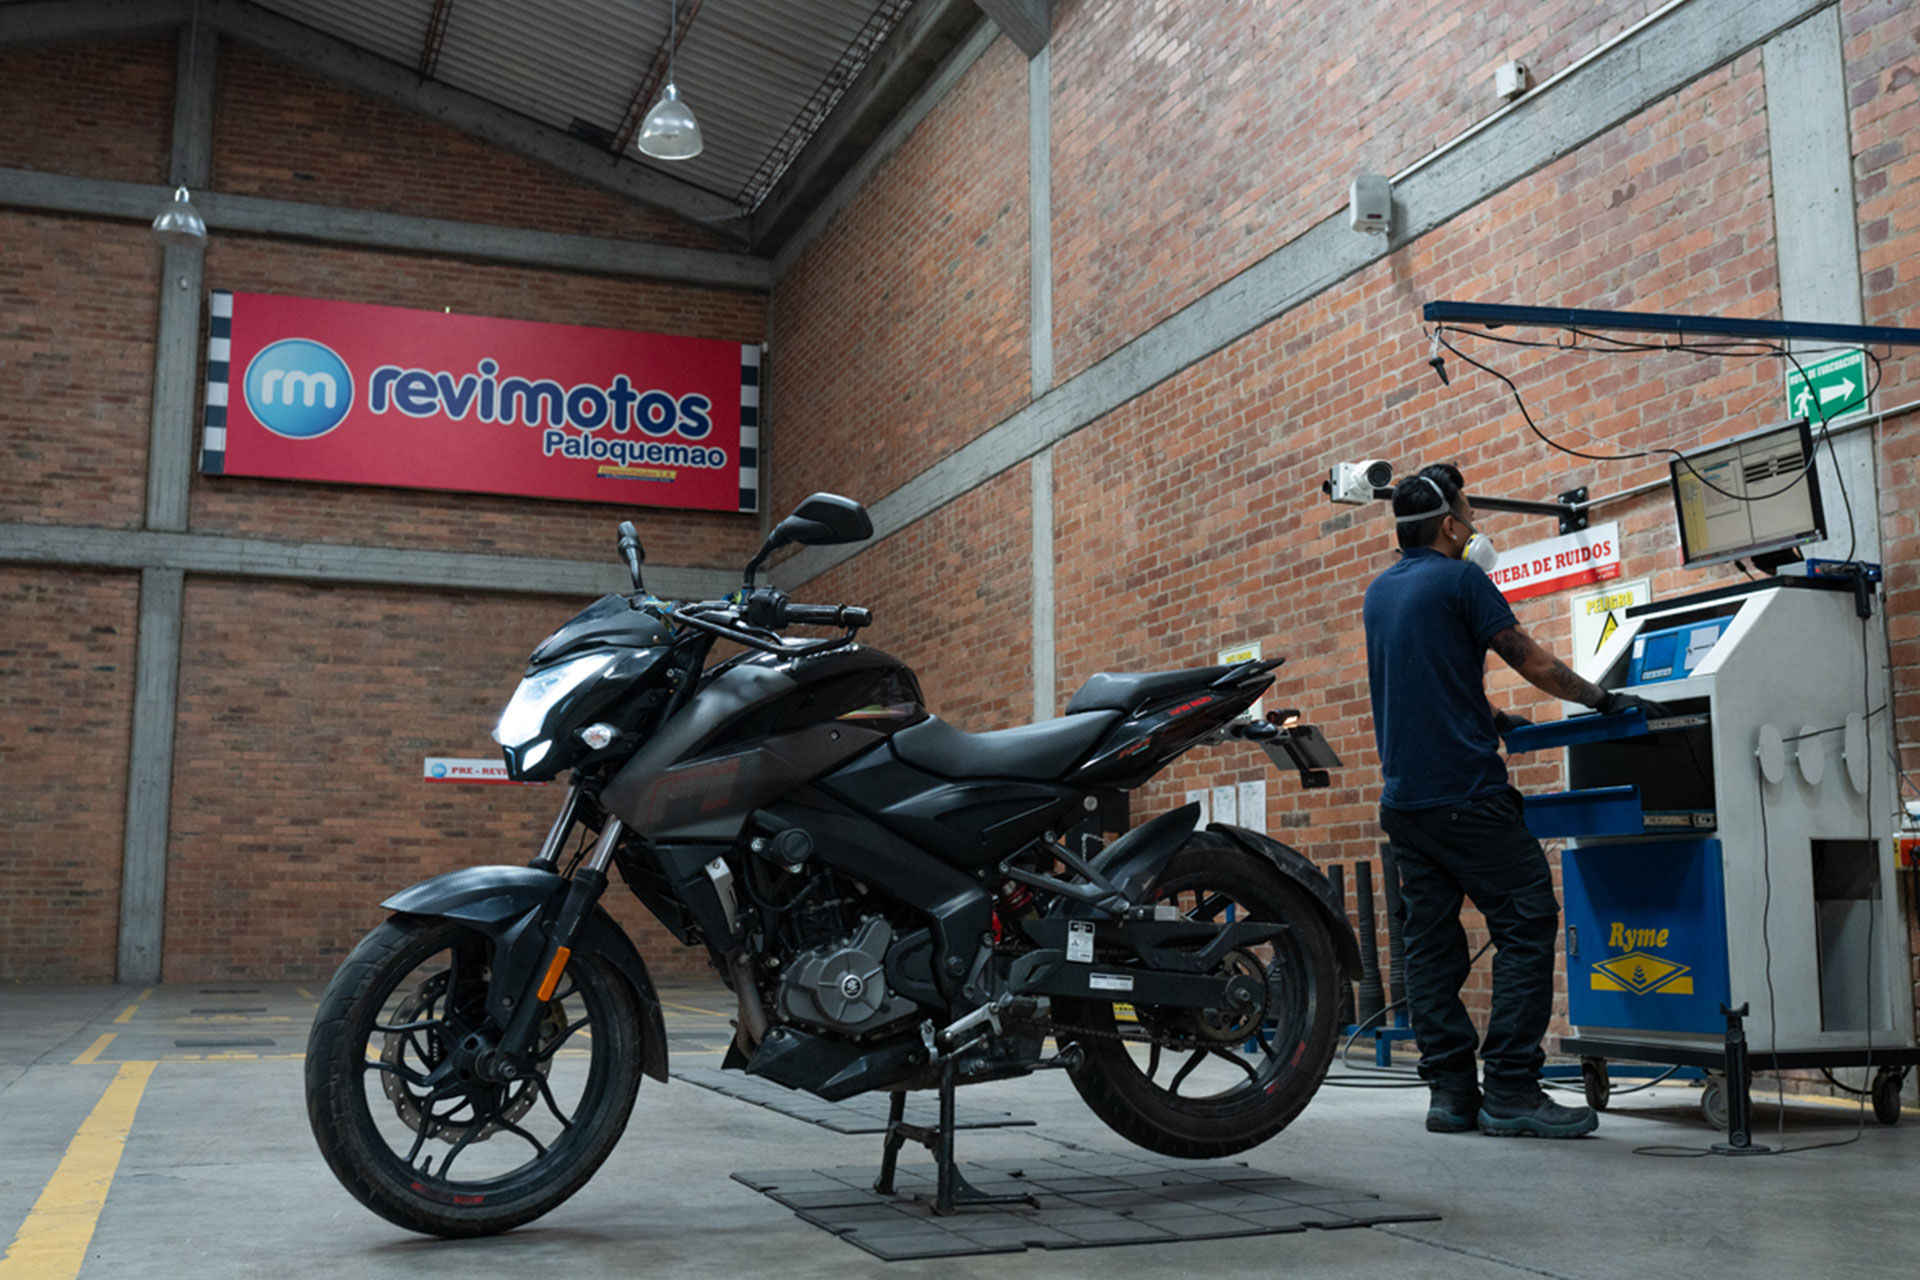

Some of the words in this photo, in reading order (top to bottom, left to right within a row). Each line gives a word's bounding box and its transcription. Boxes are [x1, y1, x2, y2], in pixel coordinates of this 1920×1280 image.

[262, 369, 337, 409] rm
[369, 357, 713, 440] revimotos
[543, 429, 727, 467] Paloquemao
[1532, 556, 1552, 576] DE
[1555, 540, 1612, 570] RUIDOS
[1586, 591, 1633, 615] PELIGRO
[452, 766, 472, 774] PRE
[1608, 922, 1669, 953] Ryme
